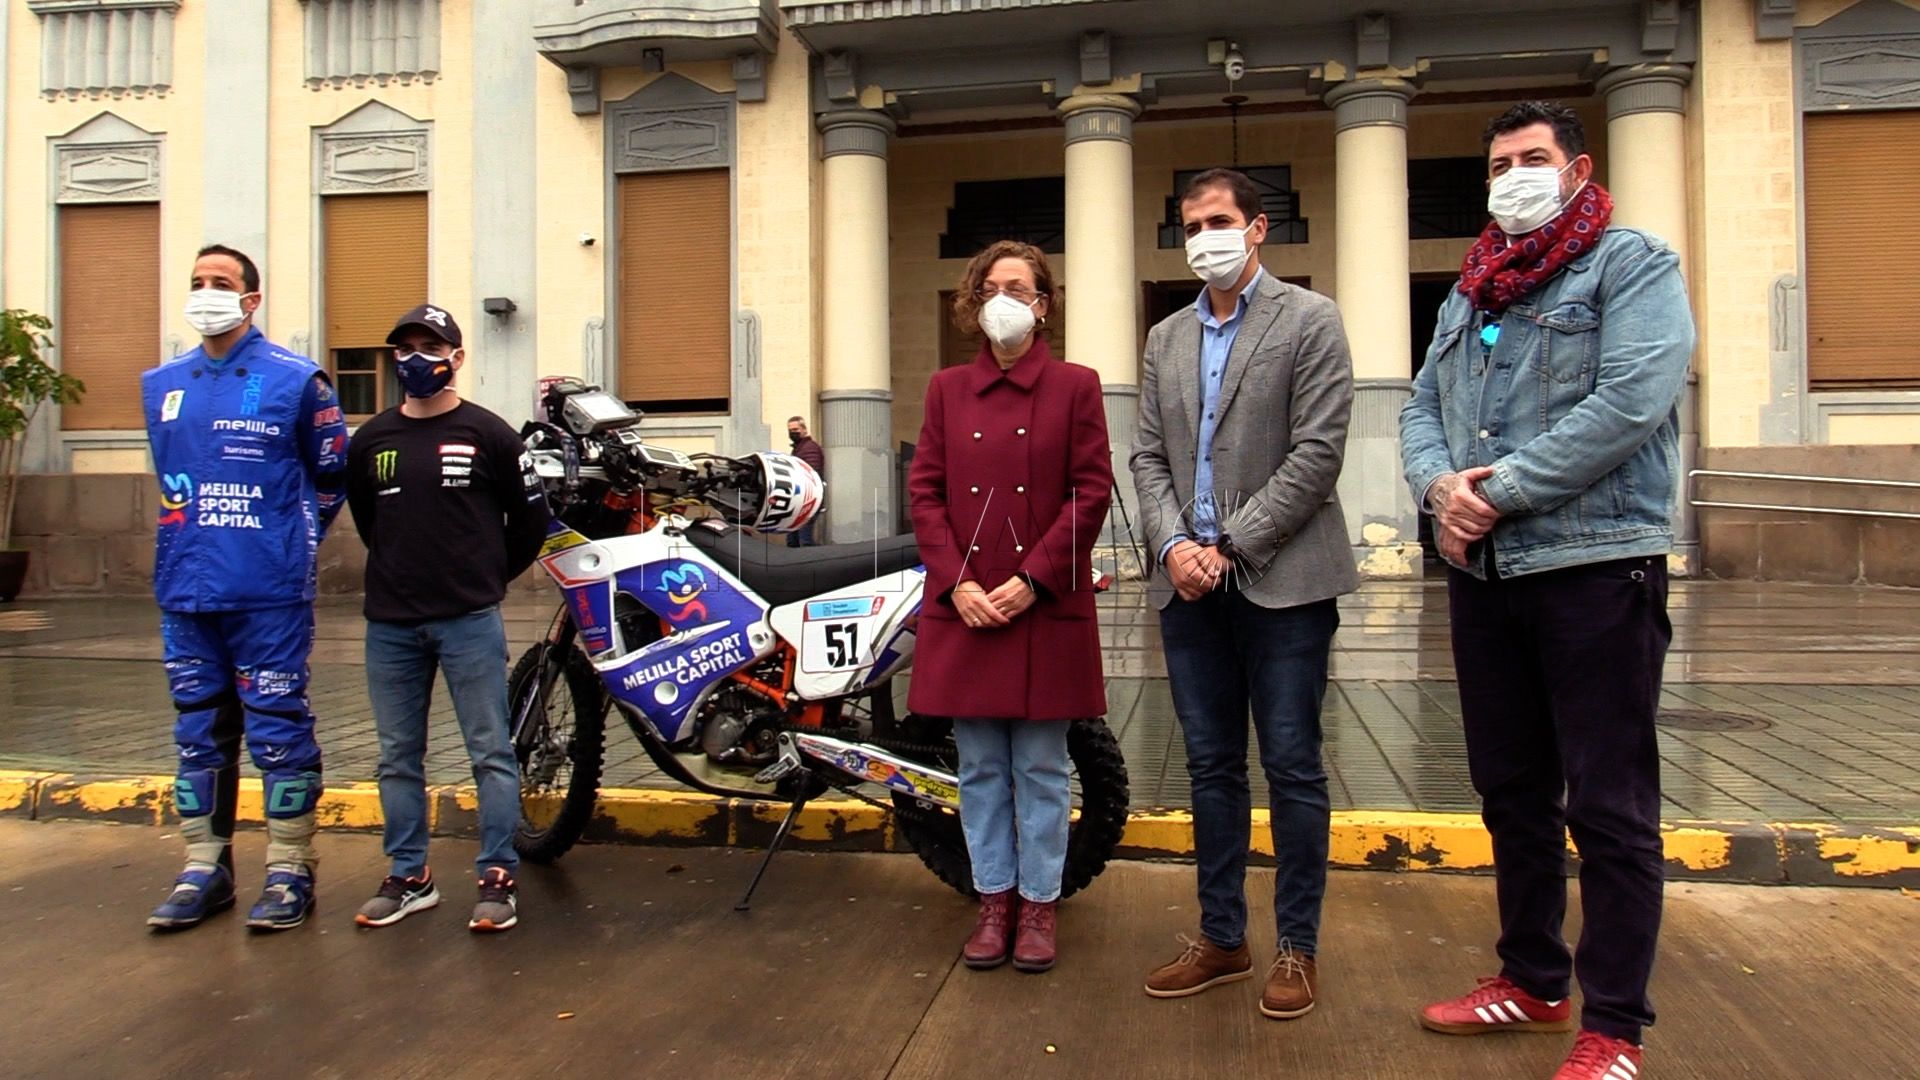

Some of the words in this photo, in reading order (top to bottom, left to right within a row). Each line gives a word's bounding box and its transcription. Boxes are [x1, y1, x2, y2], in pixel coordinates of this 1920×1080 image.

[213, 419, 280, 436] melilla
[224, 445, 264, 456] turismo
[199, 483, 263, 499] MELILLA
[198, 499, 250, 512] SPORT
[198, 513, 263, 529] CAPITAL
[825, 623, 859, 668] 51
[623, 654, 689, 690] MELILLA
[690, 633, 742, 663] SPORT
[675, 651, 747, 684] CAPITAL
